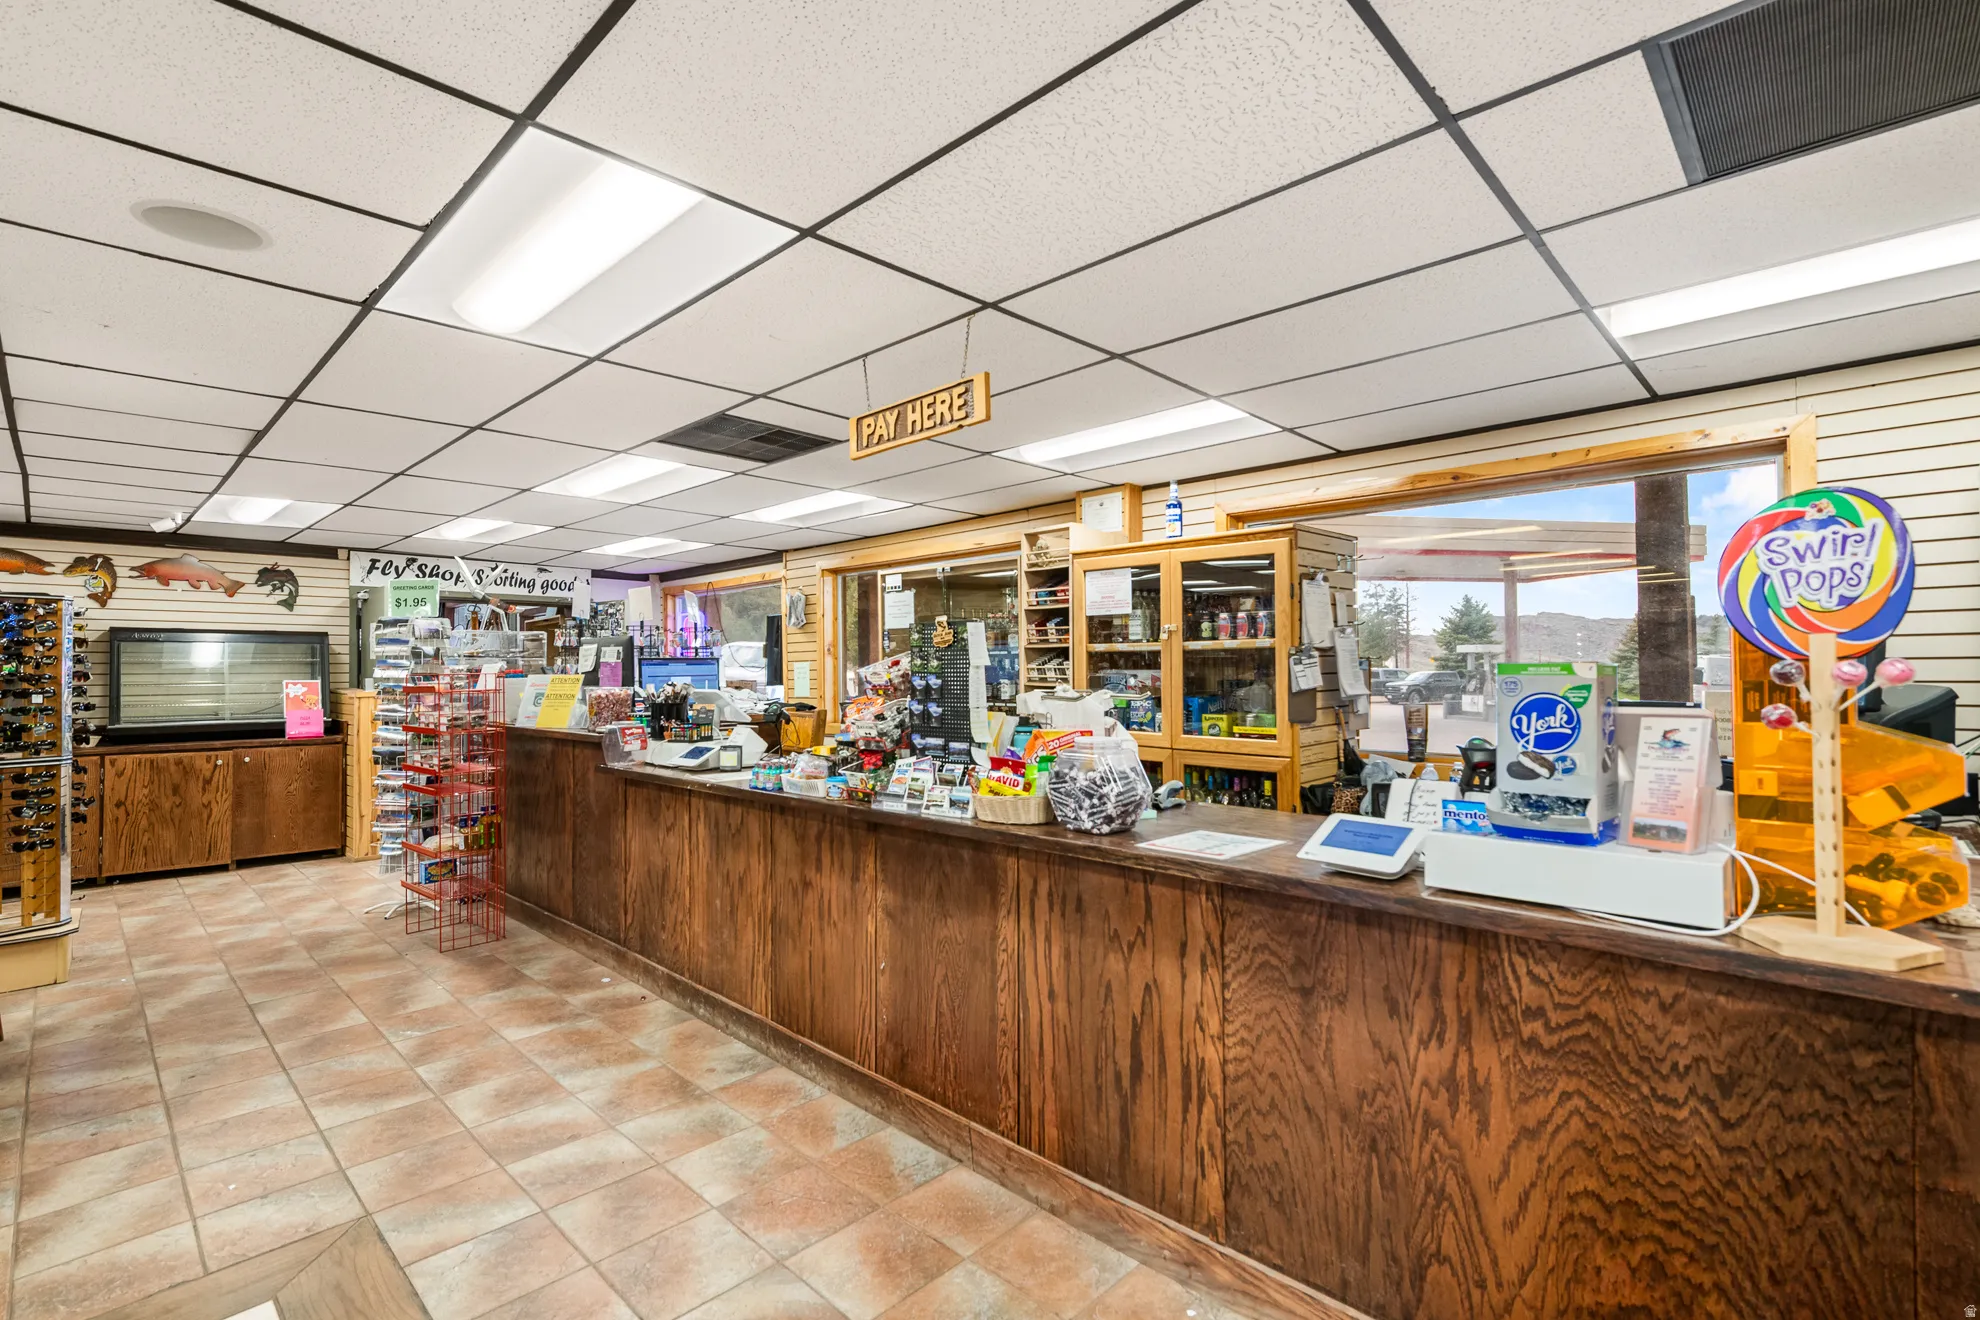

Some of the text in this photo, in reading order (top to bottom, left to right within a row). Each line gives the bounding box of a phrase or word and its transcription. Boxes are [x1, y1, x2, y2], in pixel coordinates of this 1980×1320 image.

[862, 385, 970, 448] PAY HERE
[1763, 522, 1878, 567] Swirl
[366, 557, 407, 580] Fly
[540, 576, 590, 595] good
[394, 597, 427, 609] $1.95
[1130, 699, 1152, 707] EPIC
[1047, 739, 1060, 750] 20
[1511, 703, 1575, 752] York
